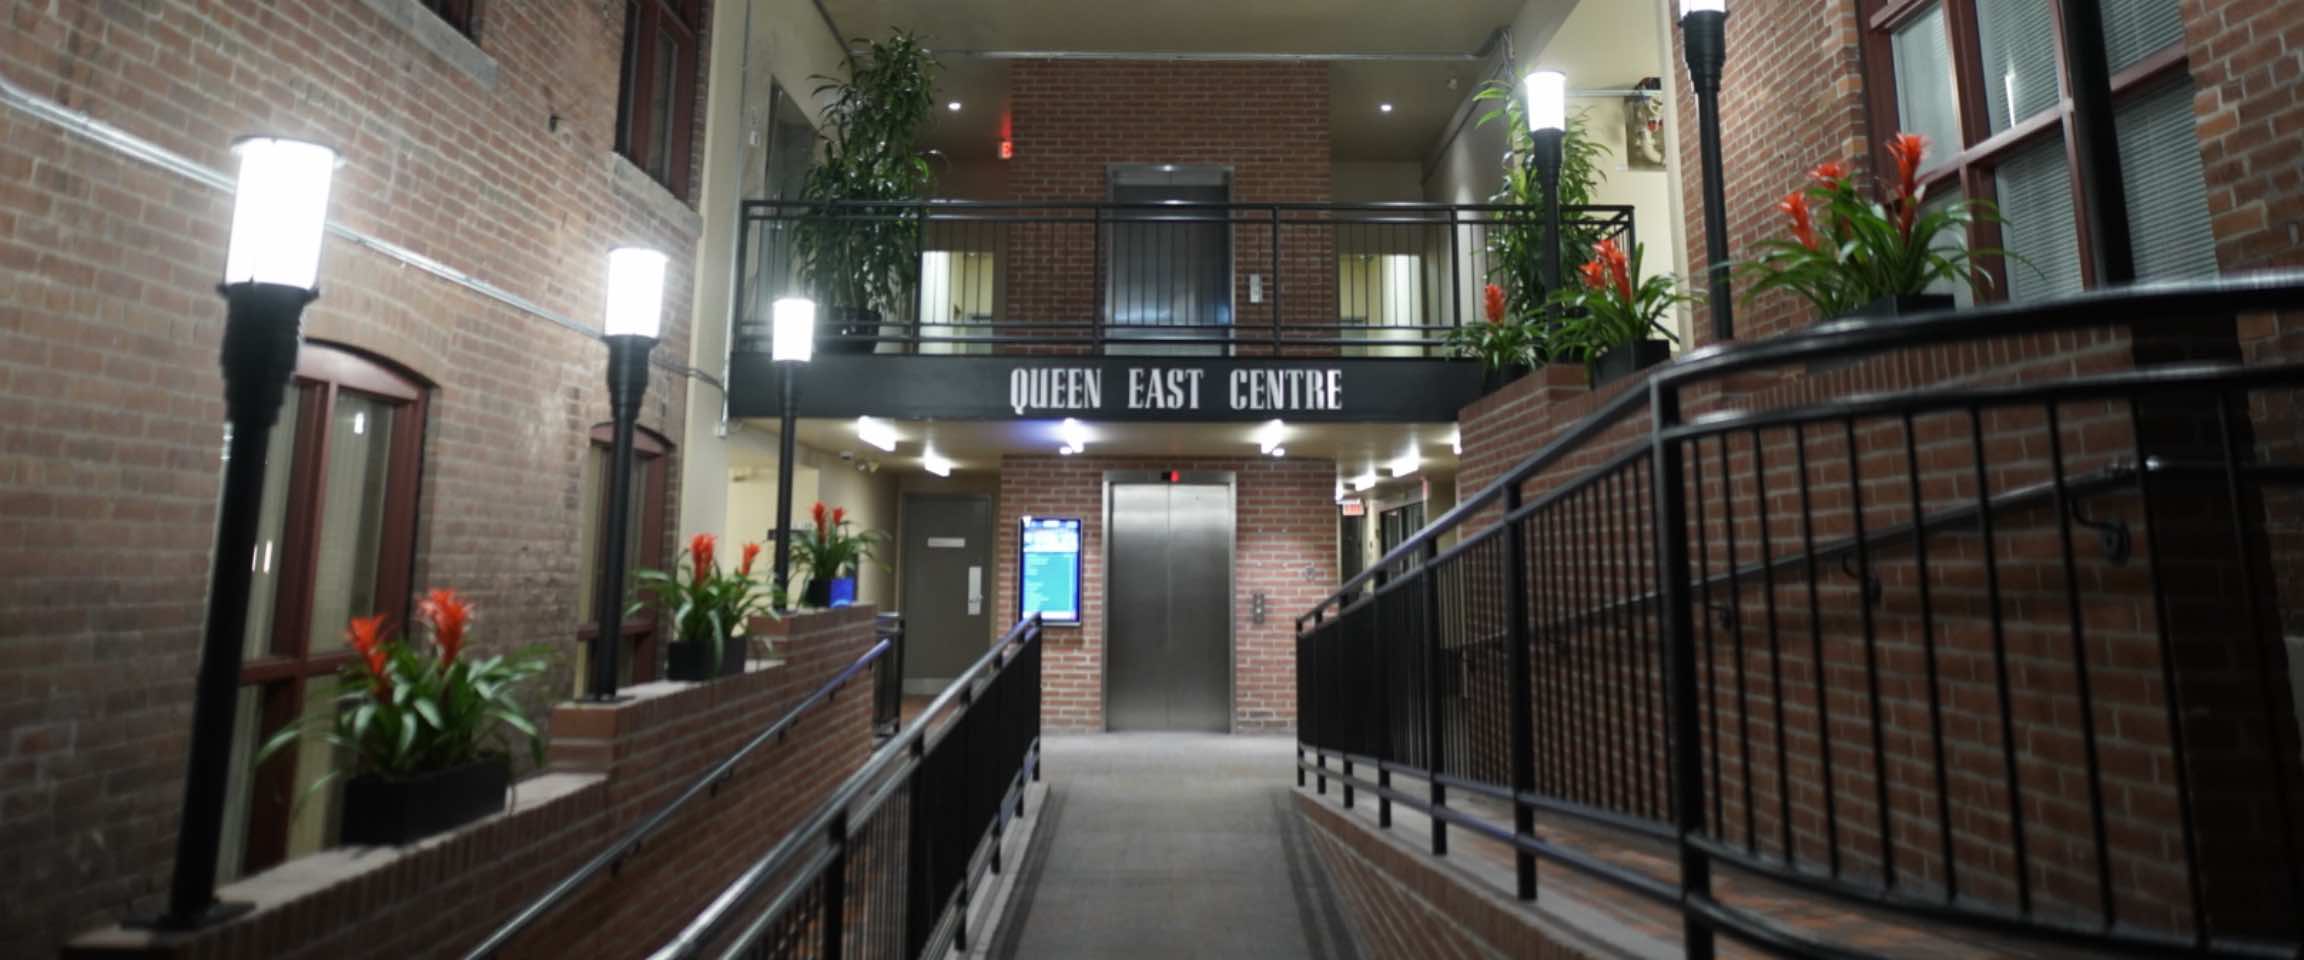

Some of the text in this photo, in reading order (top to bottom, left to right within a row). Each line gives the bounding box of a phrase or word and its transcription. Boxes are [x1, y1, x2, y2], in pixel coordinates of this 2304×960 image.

[1010, 368, 1342, 414] QUEEN EAST CENTRE
